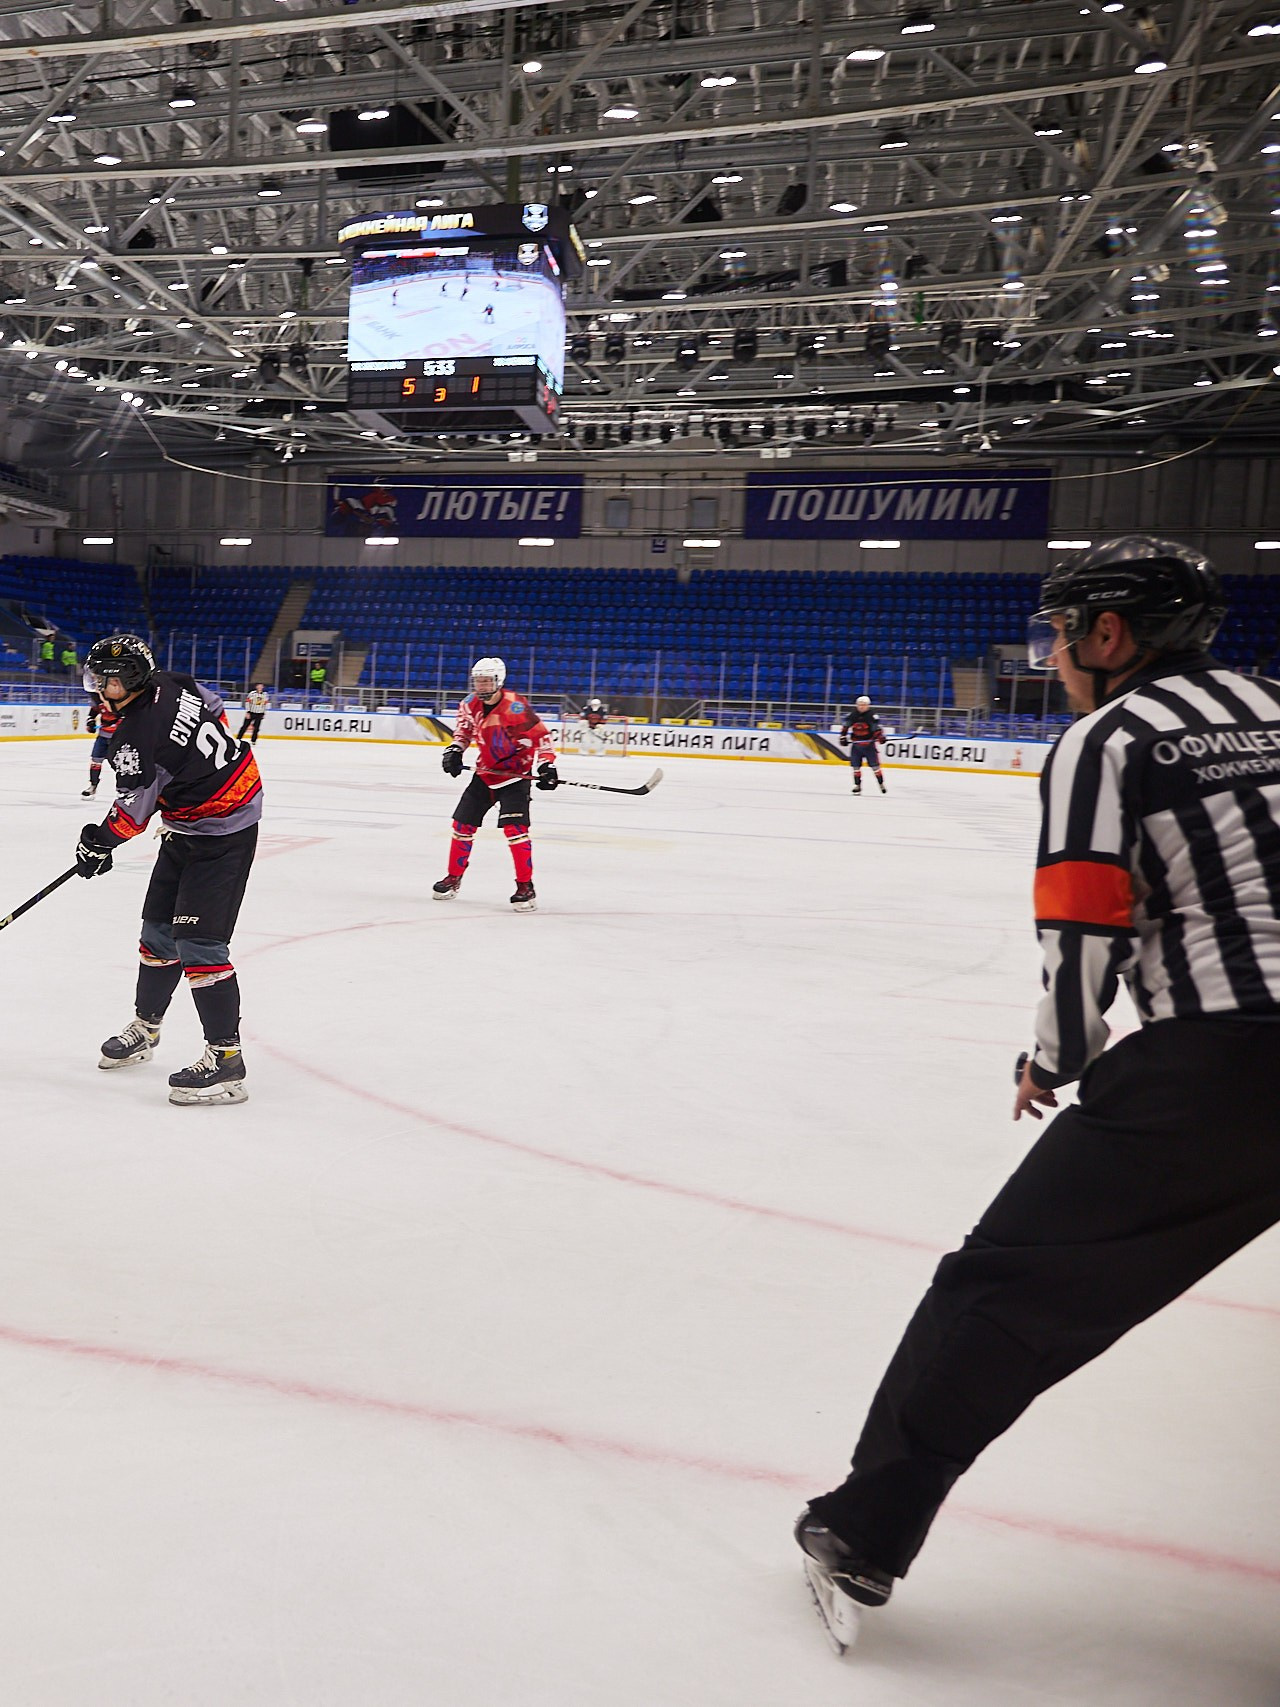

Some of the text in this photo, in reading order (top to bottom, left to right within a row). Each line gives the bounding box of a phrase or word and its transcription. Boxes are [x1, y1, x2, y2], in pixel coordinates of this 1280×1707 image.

[402, 378, 417, 395] 5
[471, 376, 481, 393] 1
[434, 387, 447, 402] 3
[416, 490, 571, 521] ЛЮТЫЕ!
[767, 487, 1019, 521] ПОШУМИМ!
[1087, 589, 1129, 600] CCM
[284, 717, 372, 733] OHLIGA.RU
[721, 736, 770, 752] ЛИГА
[885, 743, 986, 763] OHLIGA.RU
